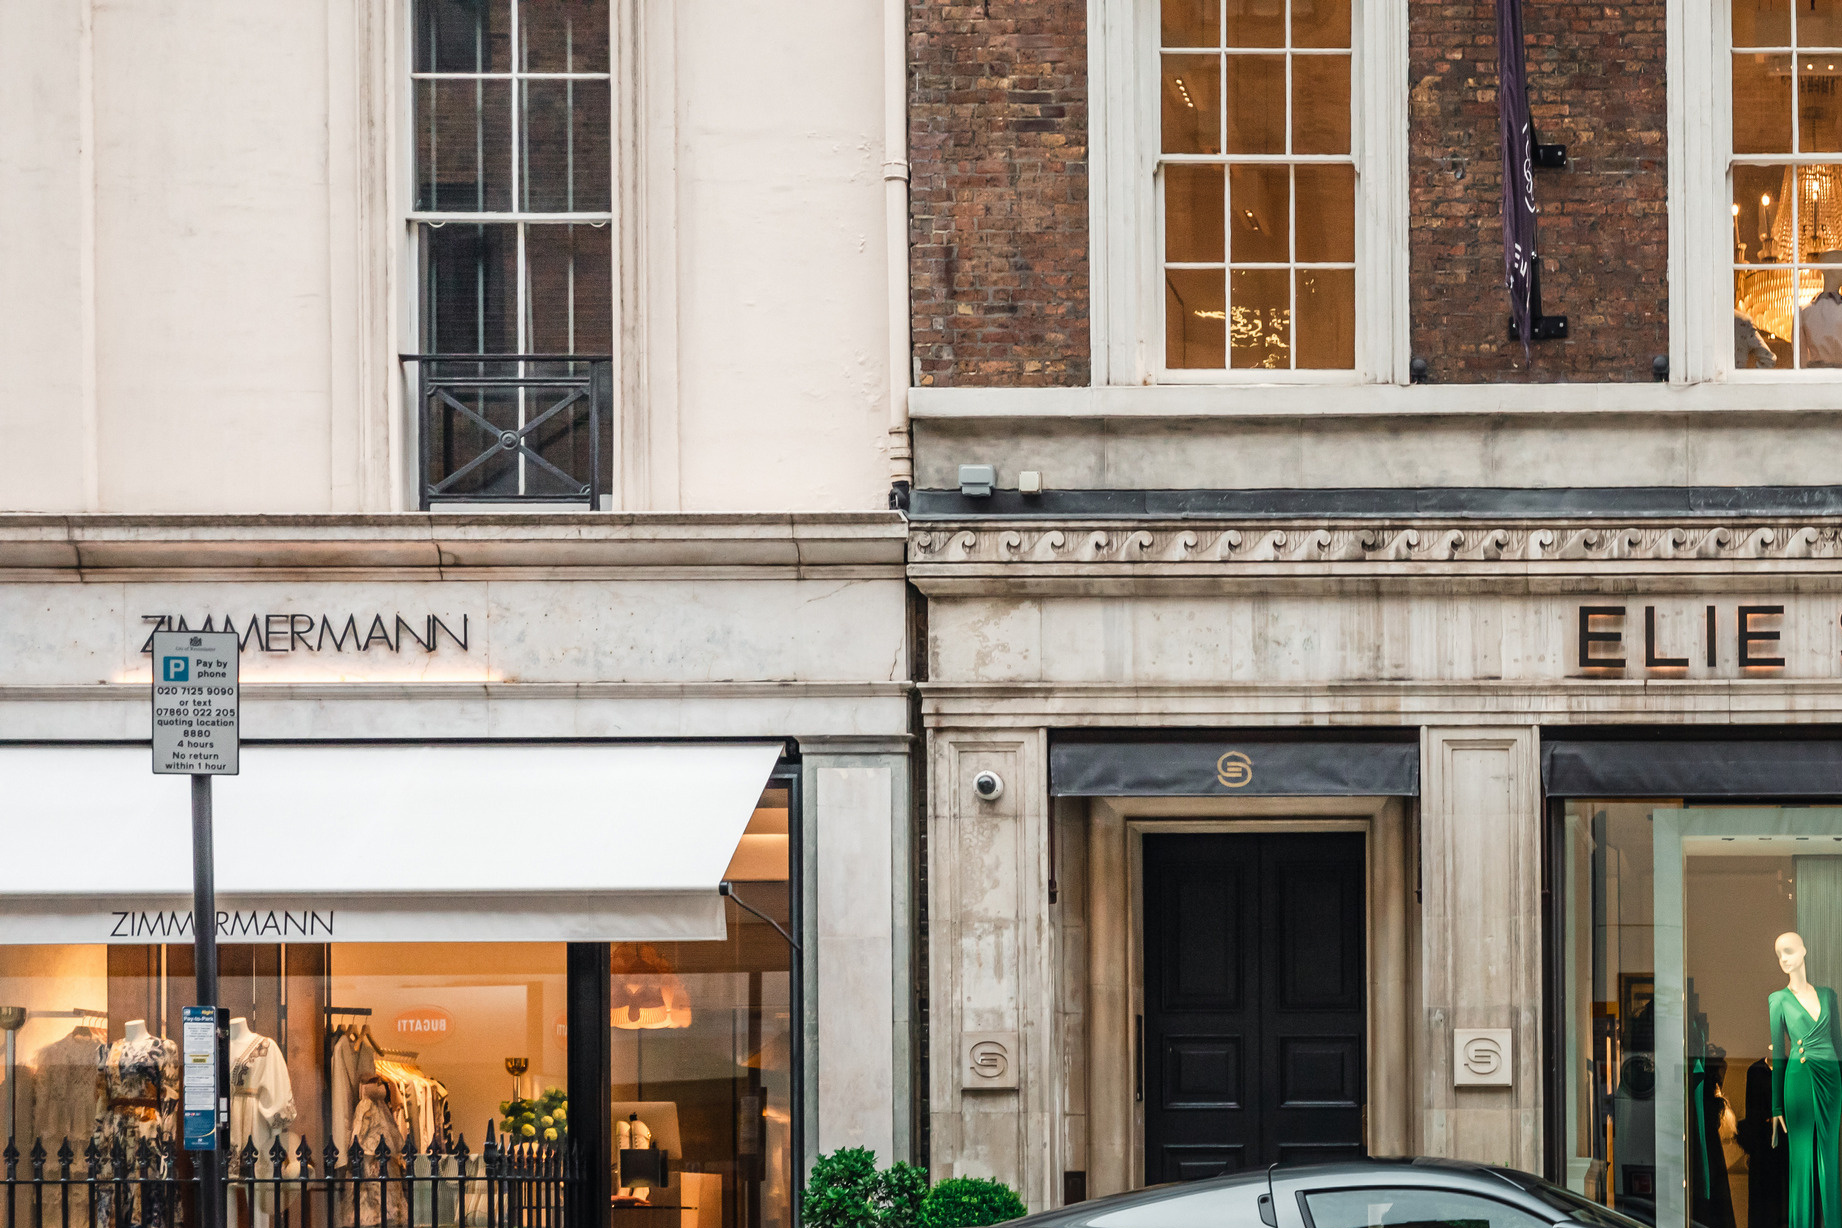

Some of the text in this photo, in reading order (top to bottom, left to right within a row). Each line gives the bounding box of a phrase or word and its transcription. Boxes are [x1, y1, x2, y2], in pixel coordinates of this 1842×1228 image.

[1578, 604, 1786, 669] ELIE
[196, 659, 228, 669] Pay by
[169, 659, 185, 679] P
[197, 670, 227, 678] phone
[157, 687, 234, 695] 020 7125 9090
[192, 699, 212, 707] text
[156, 708, 236, 717] 07860 022 205
[157, 718, 235, 728] quoting location
[183, 729, 211, 738] 8880
[177, 740, 214, 749] 4 hours
[172, 751, 219, 760] No return
[165, 761, 194, 770] within
[205, 762, 227, 770] hour
[110, 910, 334, 937] ZIMMRMANN
